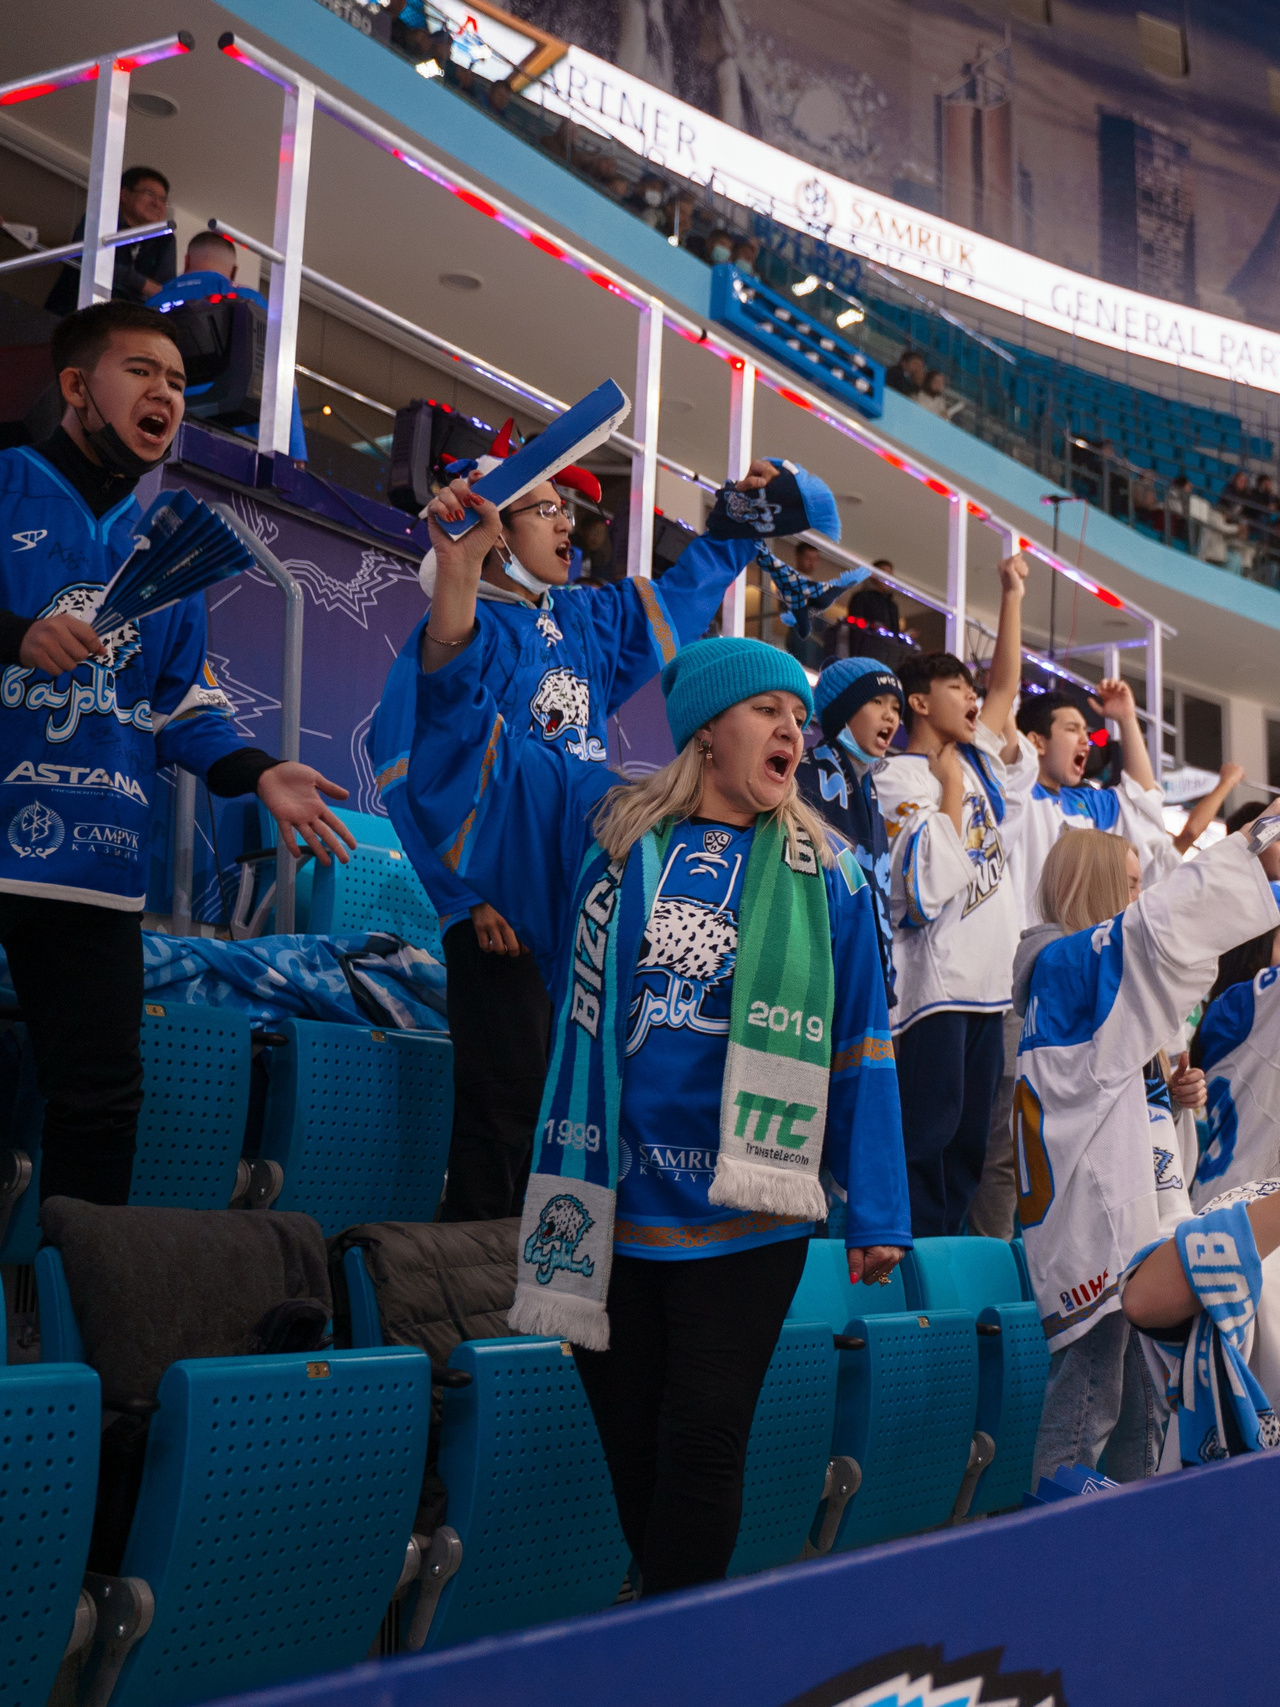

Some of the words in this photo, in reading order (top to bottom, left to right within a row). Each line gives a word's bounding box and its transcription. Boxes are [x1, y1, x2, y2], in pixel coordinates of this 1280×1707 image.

[540, 66, 697, 154] ARTNER
[851, 201, 975, 273] SAMRUK
[1050, 284, 1204, 358] GENERAL
[3, 760, 150, 805] ASTANA
[72, 825, 140, 850] САМРУК
[747, 1000, 824, 1043] 2019
[544, 1118, 601, 1153] 1999
[639, 1143, 717, 1170] SAMRU
[639, 1163, 715, 1183] KAZYN
[1185, 1231, 1257, 1335] LUB
[313, 1365, 321, 1376] 3
